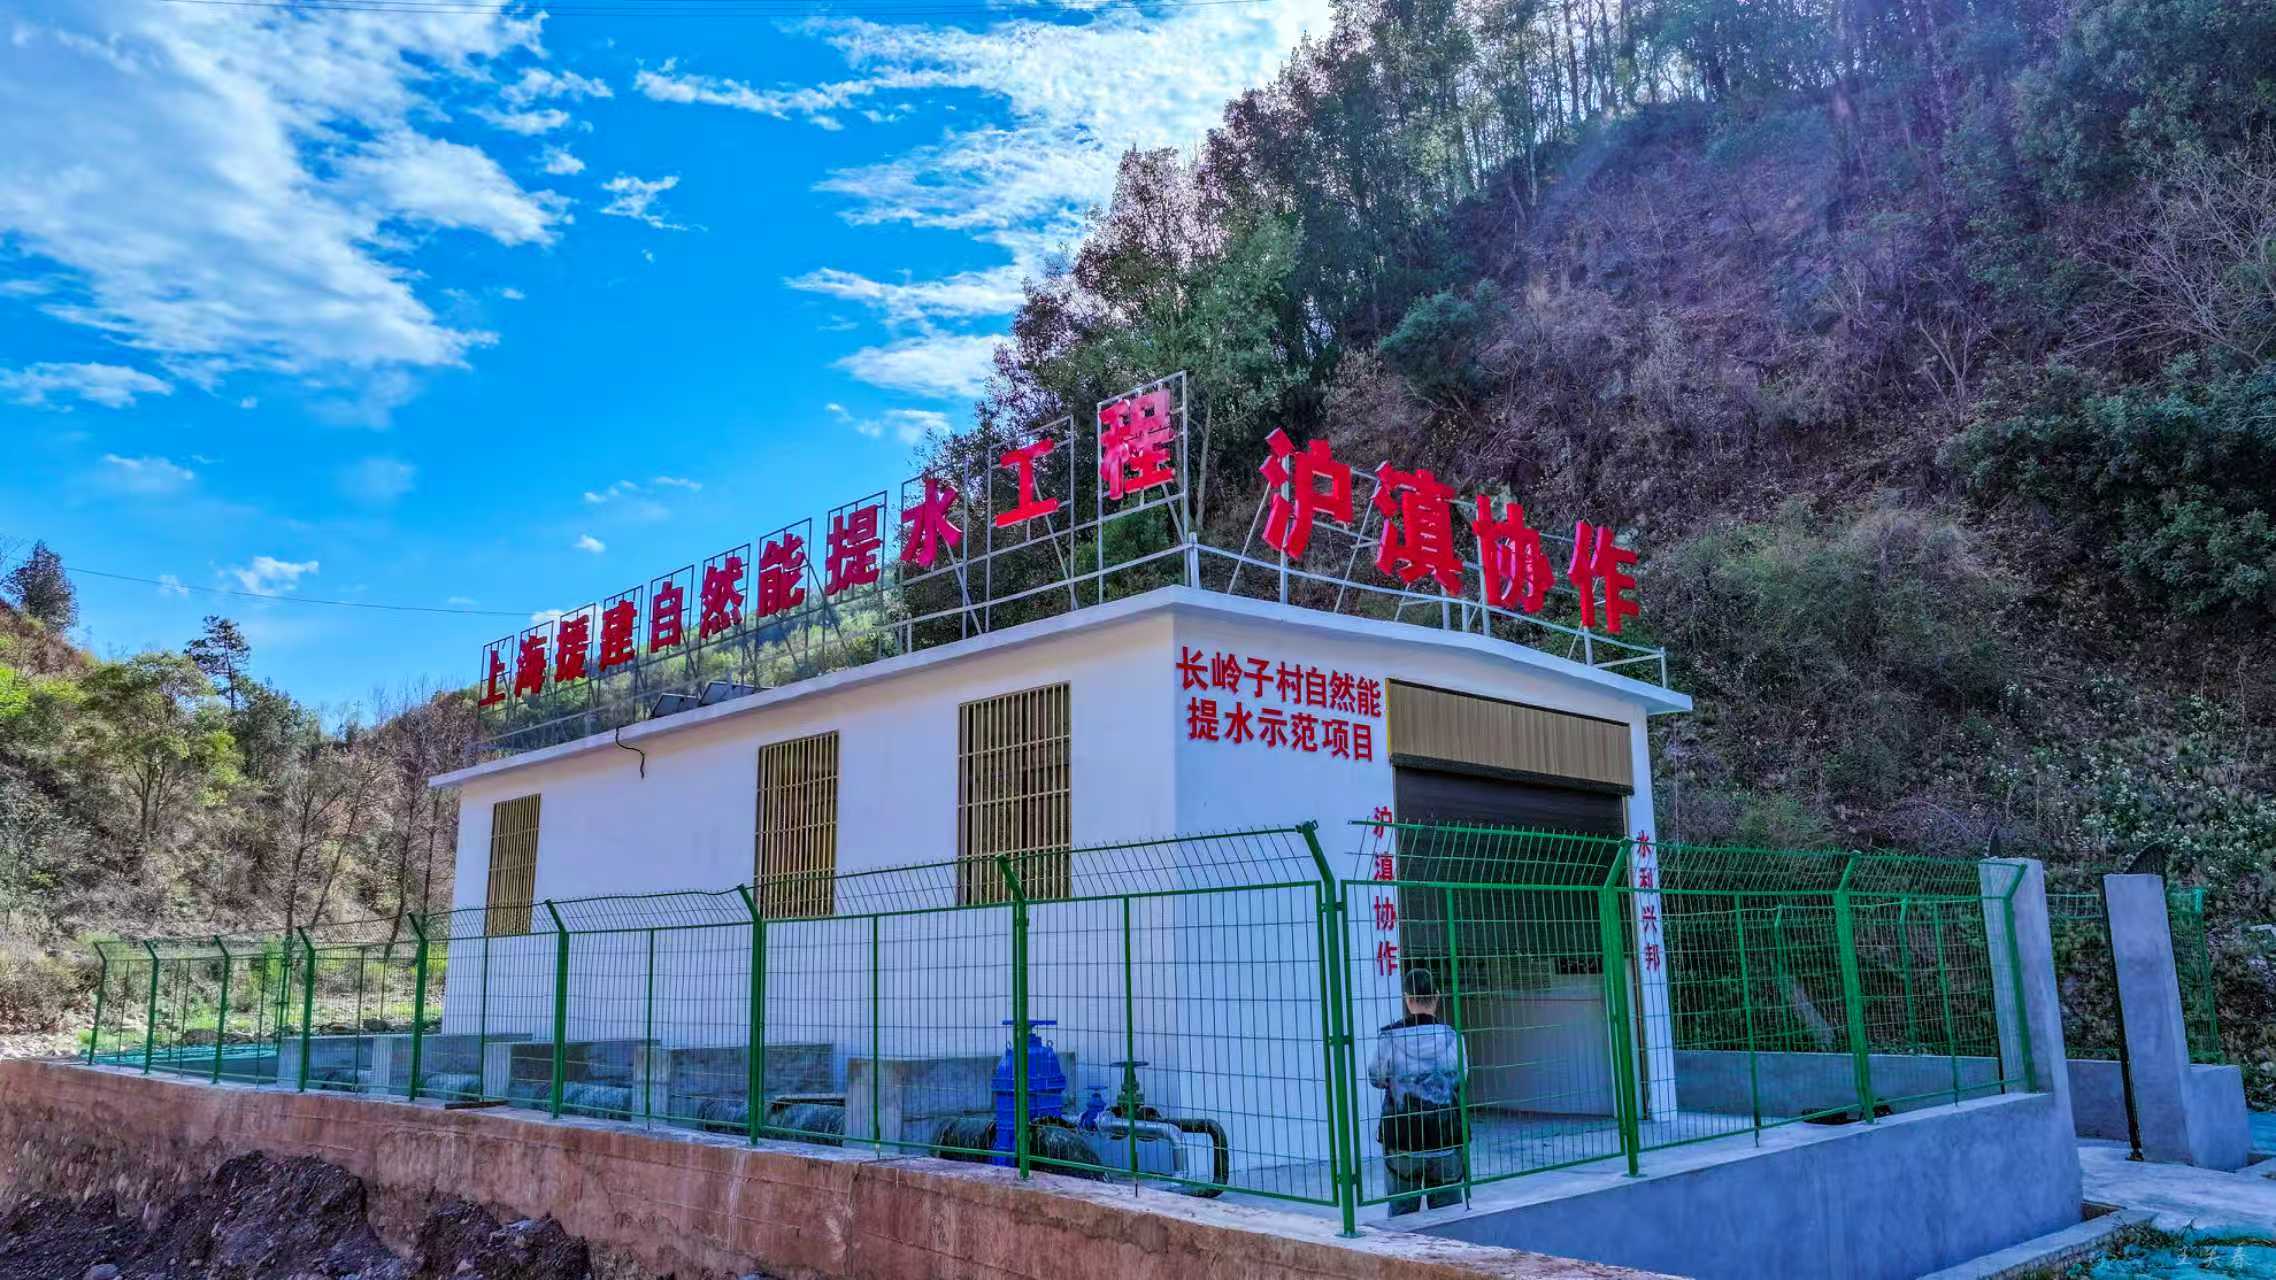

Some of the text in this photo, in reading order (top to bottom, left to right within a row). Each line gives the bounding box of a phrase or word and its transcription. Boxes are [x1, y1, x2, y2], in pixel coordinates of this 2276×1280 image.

[480, 388, 1177, 706] 上海援建自然能提水工程
[1258, 427, 1640, 634] 沪滇协作
[1176, 646, 1382, 718] 长岭子村自然能
[1187, 696, 1373, 762] 提水示范项目
[1373, 805, 1398, 976] 沪滇协作
[1636, 830, 1661, 971] 水利兴邦
